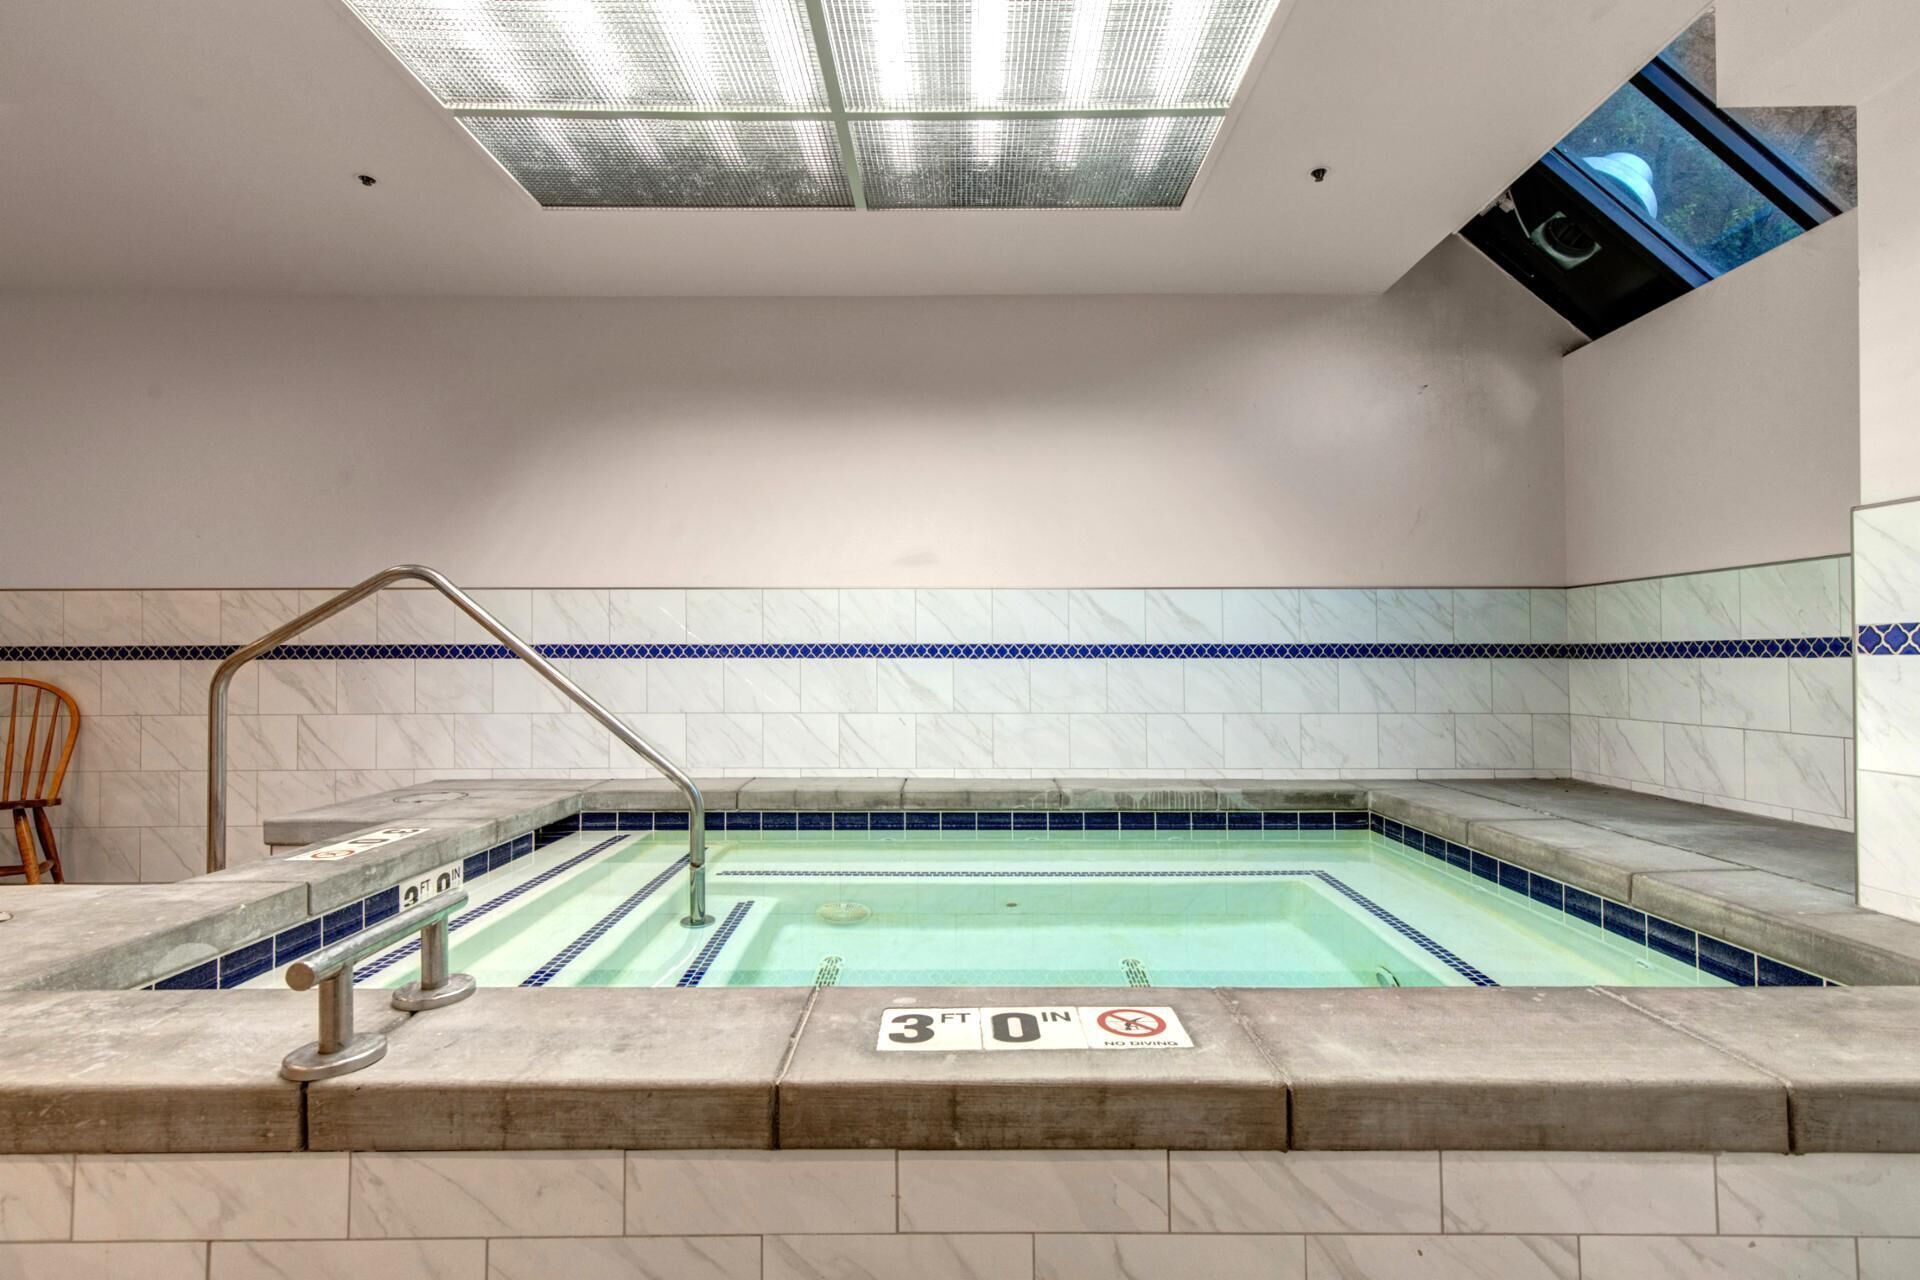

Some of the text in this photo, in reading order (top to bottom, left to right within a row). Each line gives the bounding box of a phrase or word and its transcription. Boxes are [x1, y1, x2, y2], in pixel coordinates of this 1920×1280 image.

[404, 866, 461, 908] 3 FT 0 IN
[888, 1011, 1072, 1044] 3 FT 0 IN
